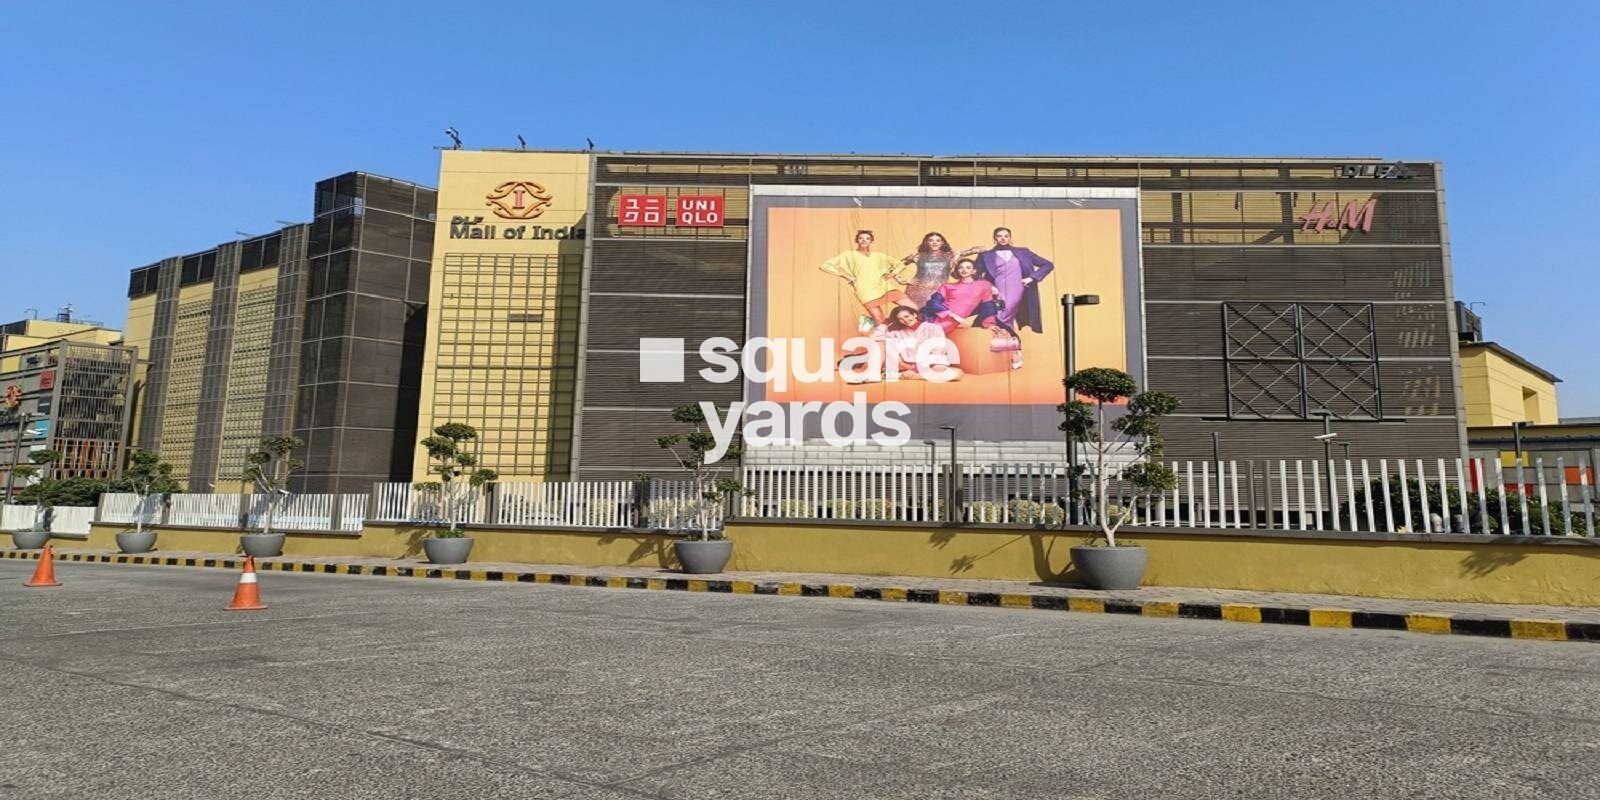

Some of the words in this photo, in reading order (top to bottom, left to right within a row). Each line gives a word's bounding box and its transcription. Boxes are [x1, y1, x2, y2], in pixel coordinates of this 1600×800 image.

[626, 199, 660, 210] ユニ
[682, 200, 716, 211] UNI
[451, 216, 484, 225] DLF
[624, 211, 659, 223] クロ
[682, 212, 718, 224] QLO
[1300, 198, 1377, 233] H&M
[450, 225, 496, 239] Mall
[503, 226, 526, 240] of
[532, 226, 586, 240] India
